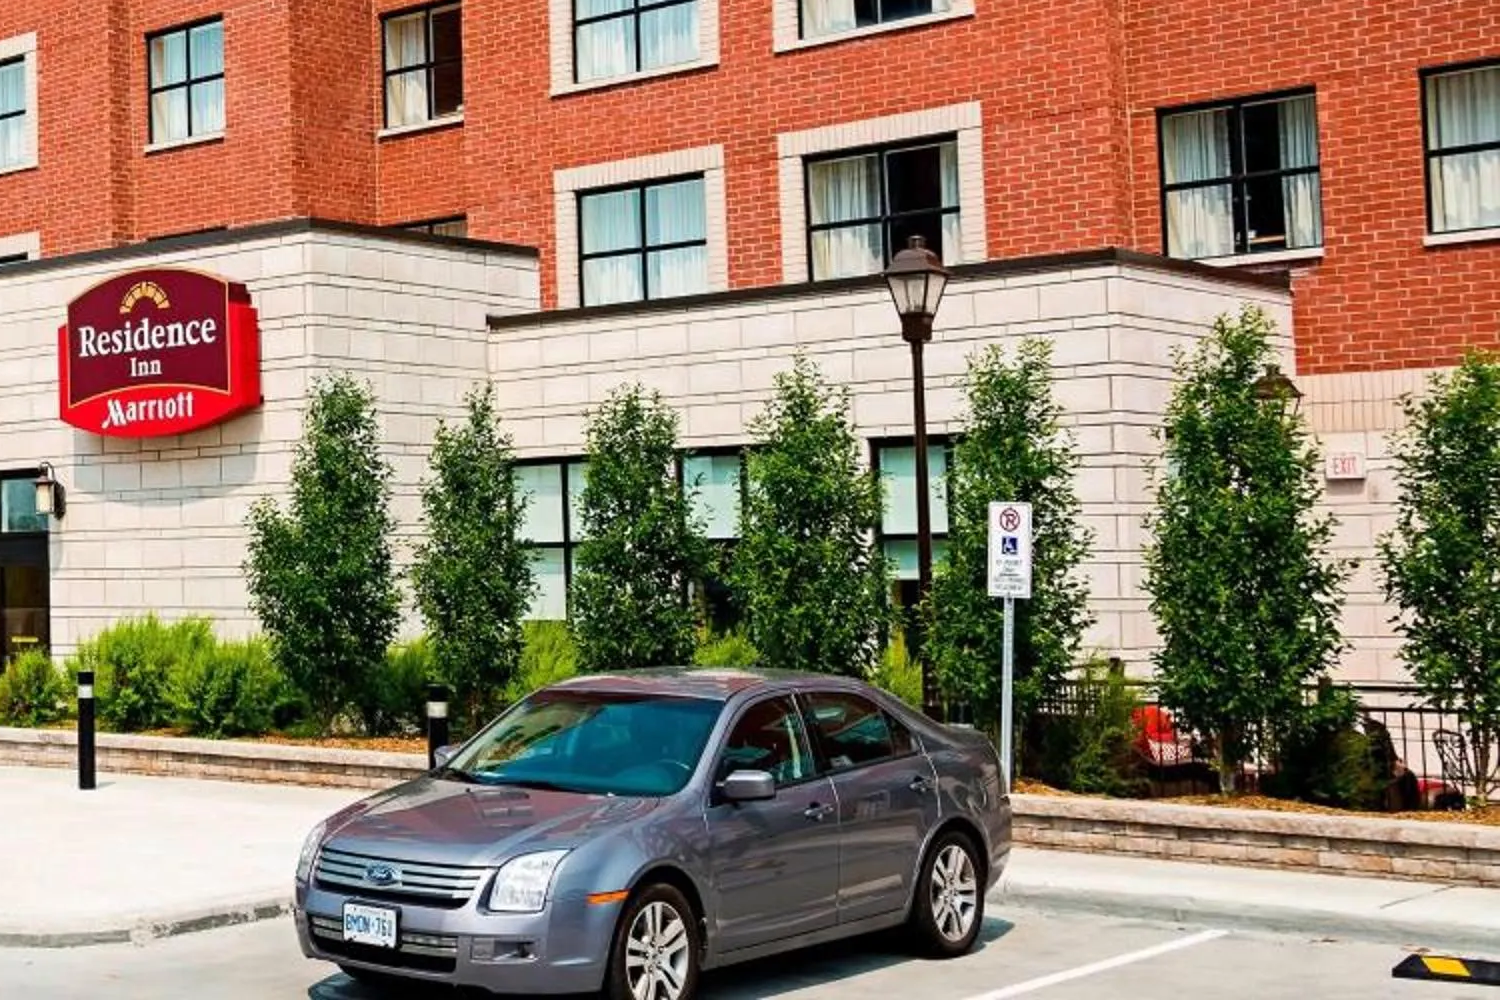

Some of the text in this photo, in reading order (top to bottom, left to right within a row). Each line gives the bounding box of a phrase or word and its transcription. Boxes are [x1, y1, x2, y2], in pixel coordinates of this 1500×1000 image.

[79, 317, 217, 358] Residence
[130, 357, 162, 377] Inn
[102, 391, 194, 429] Marriott
[1332, 455, 1357, 475] EXIT
